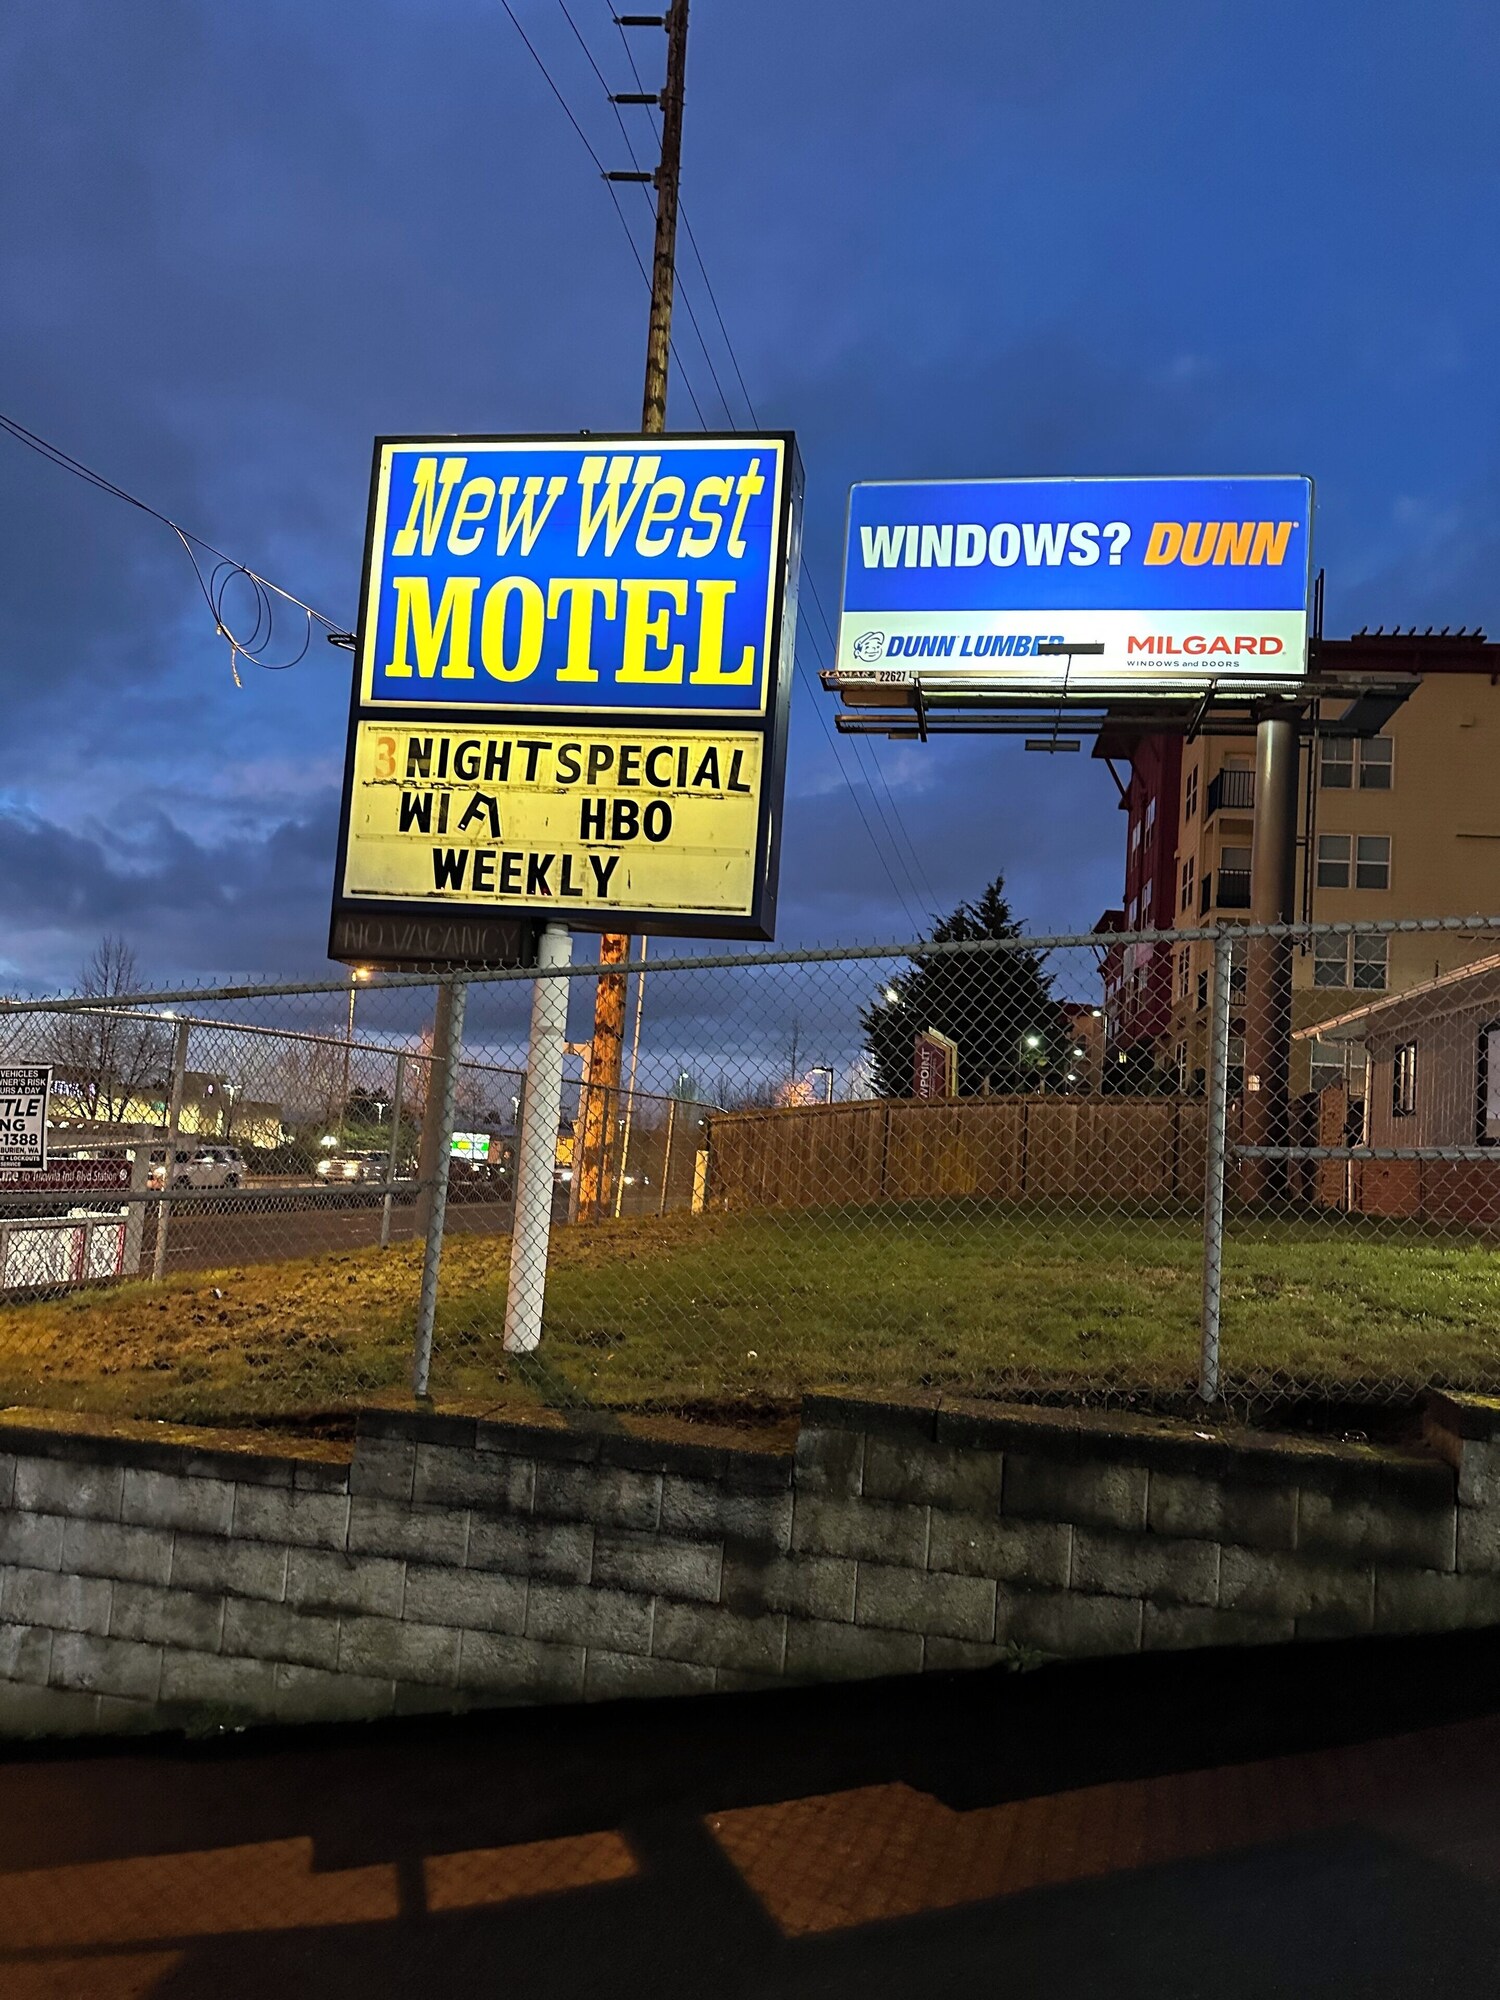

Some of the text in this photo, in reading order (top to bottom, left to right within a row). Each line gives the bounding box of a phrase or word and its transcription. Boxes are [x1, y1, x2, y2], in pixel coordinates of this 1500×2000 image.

[392, 456, 764, 559] New West
[859, 521, 1293, 568] WINDOWS? DUNN
[384, 576, 755, 686] MOTEL
[886, 636, 957, 657] DUNN
[1127, 635, 1284, 655] MILGARD
[880, 671, 906, 682] 22627
[1127, 660, 1240, 668] WINDOWS and DOORS
[375, 736, 751, 793] 3 NIGHT SPECIAL
[579, 797, 673, 843] HBO
[432, 847, 620, 898] WEEKLY
[344, 921, 518, 956] NO VACANCY
[1, 1070, 39, 1078] VEHICLES
